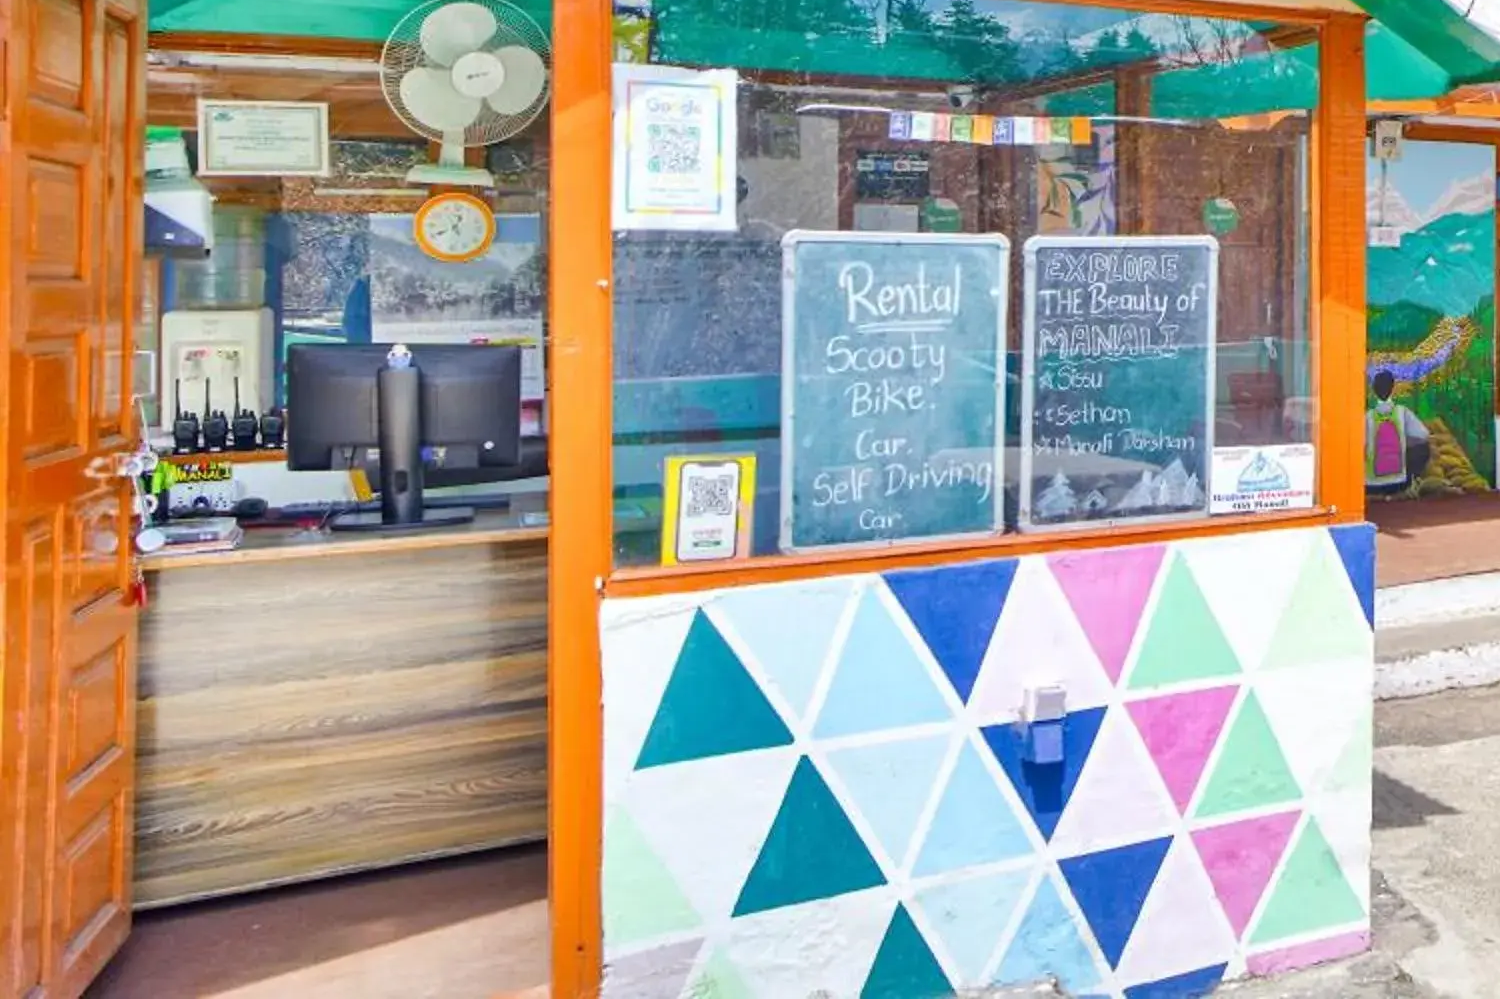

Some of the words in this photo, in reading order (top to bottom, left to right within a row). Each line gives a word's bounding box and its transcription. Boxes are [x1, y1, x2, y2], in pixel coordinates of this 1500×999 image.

[1044, 252, 1180, 283] EXPLORE
[839, 261, 961, 323] Rental
[1038, 287, 1084, 316] THE
[1088, 282, 1168, 327] Beauty
[1176, 282, 1206, 312] of
[826, 332, 945, 386] Scooty
[1039, 323, 1180, 360] MANALI
[1057, 365, 1103, 390] Sissu
[1055, 401, 1131, 426] Sethan
[813, 467, 873, 506] Self
[884, 459, 992, 504] Driving
